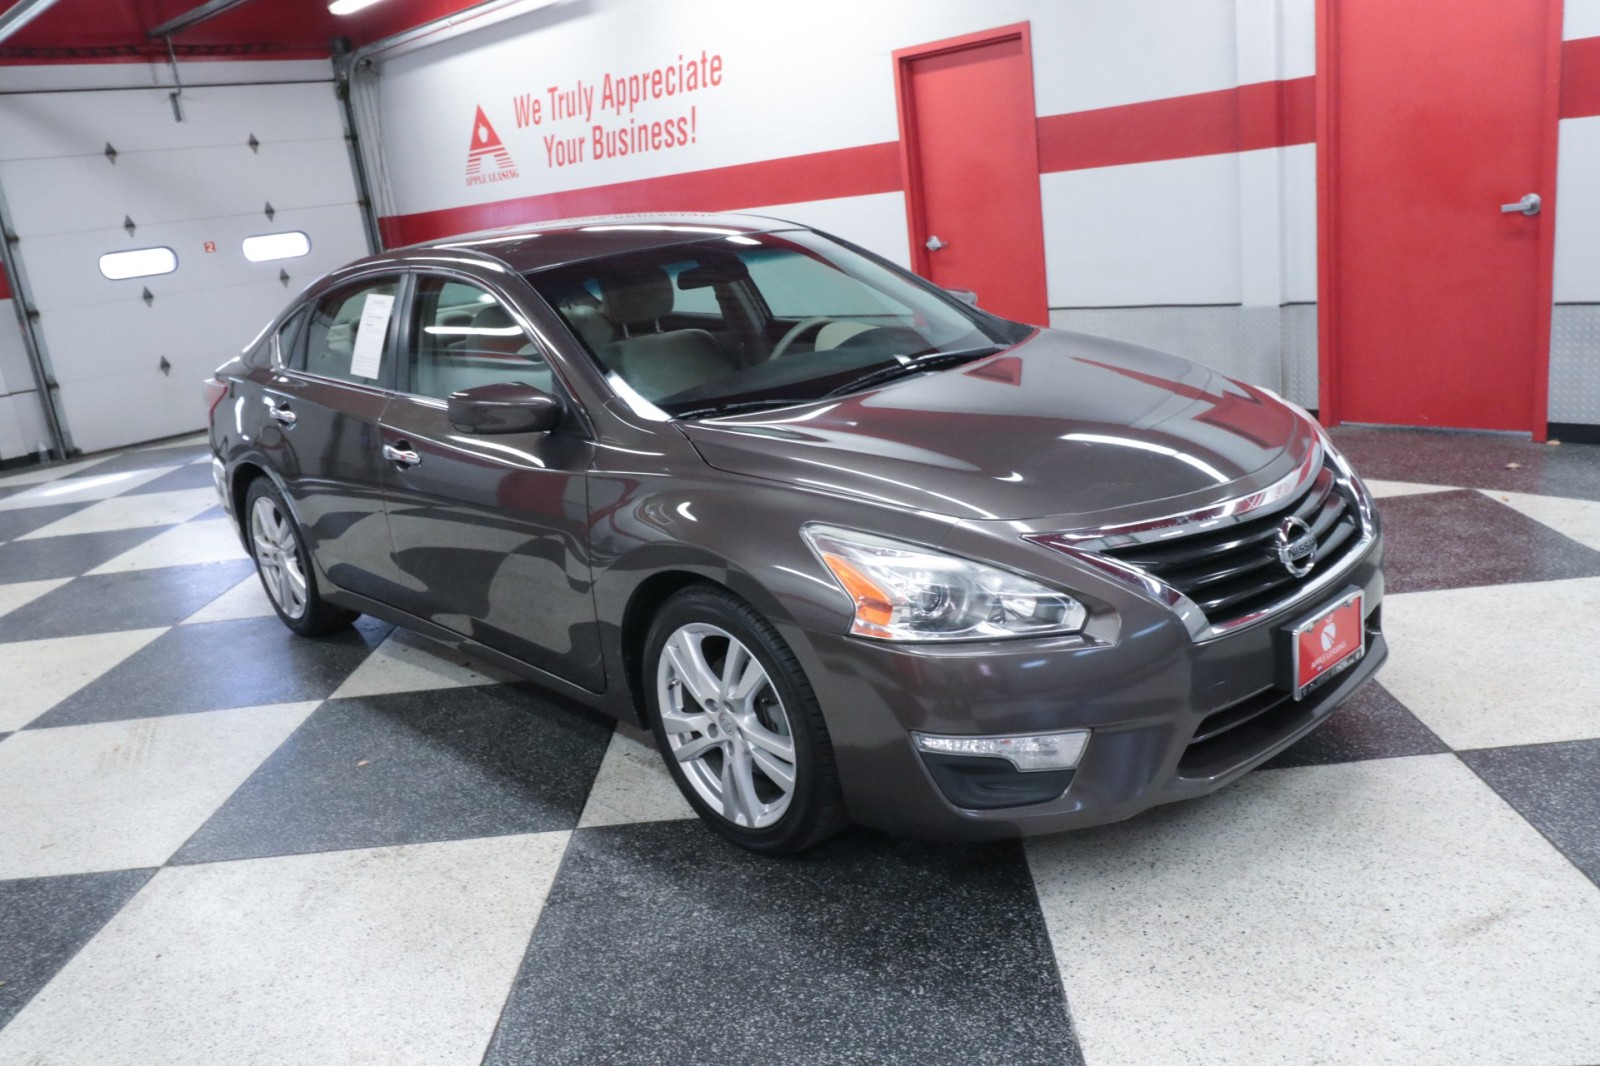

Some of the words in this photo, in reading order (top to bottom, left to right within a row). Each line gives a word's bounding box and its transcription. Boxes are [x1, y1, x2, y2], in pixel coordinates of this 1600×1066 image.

[513, 93, 542, 129] We
[547, 80, 594, 123] Truly
[601, 50, 723, 116] Appreciate
[543, 134, 586, 169] Your
[592, 105, 697, 160] Business!
